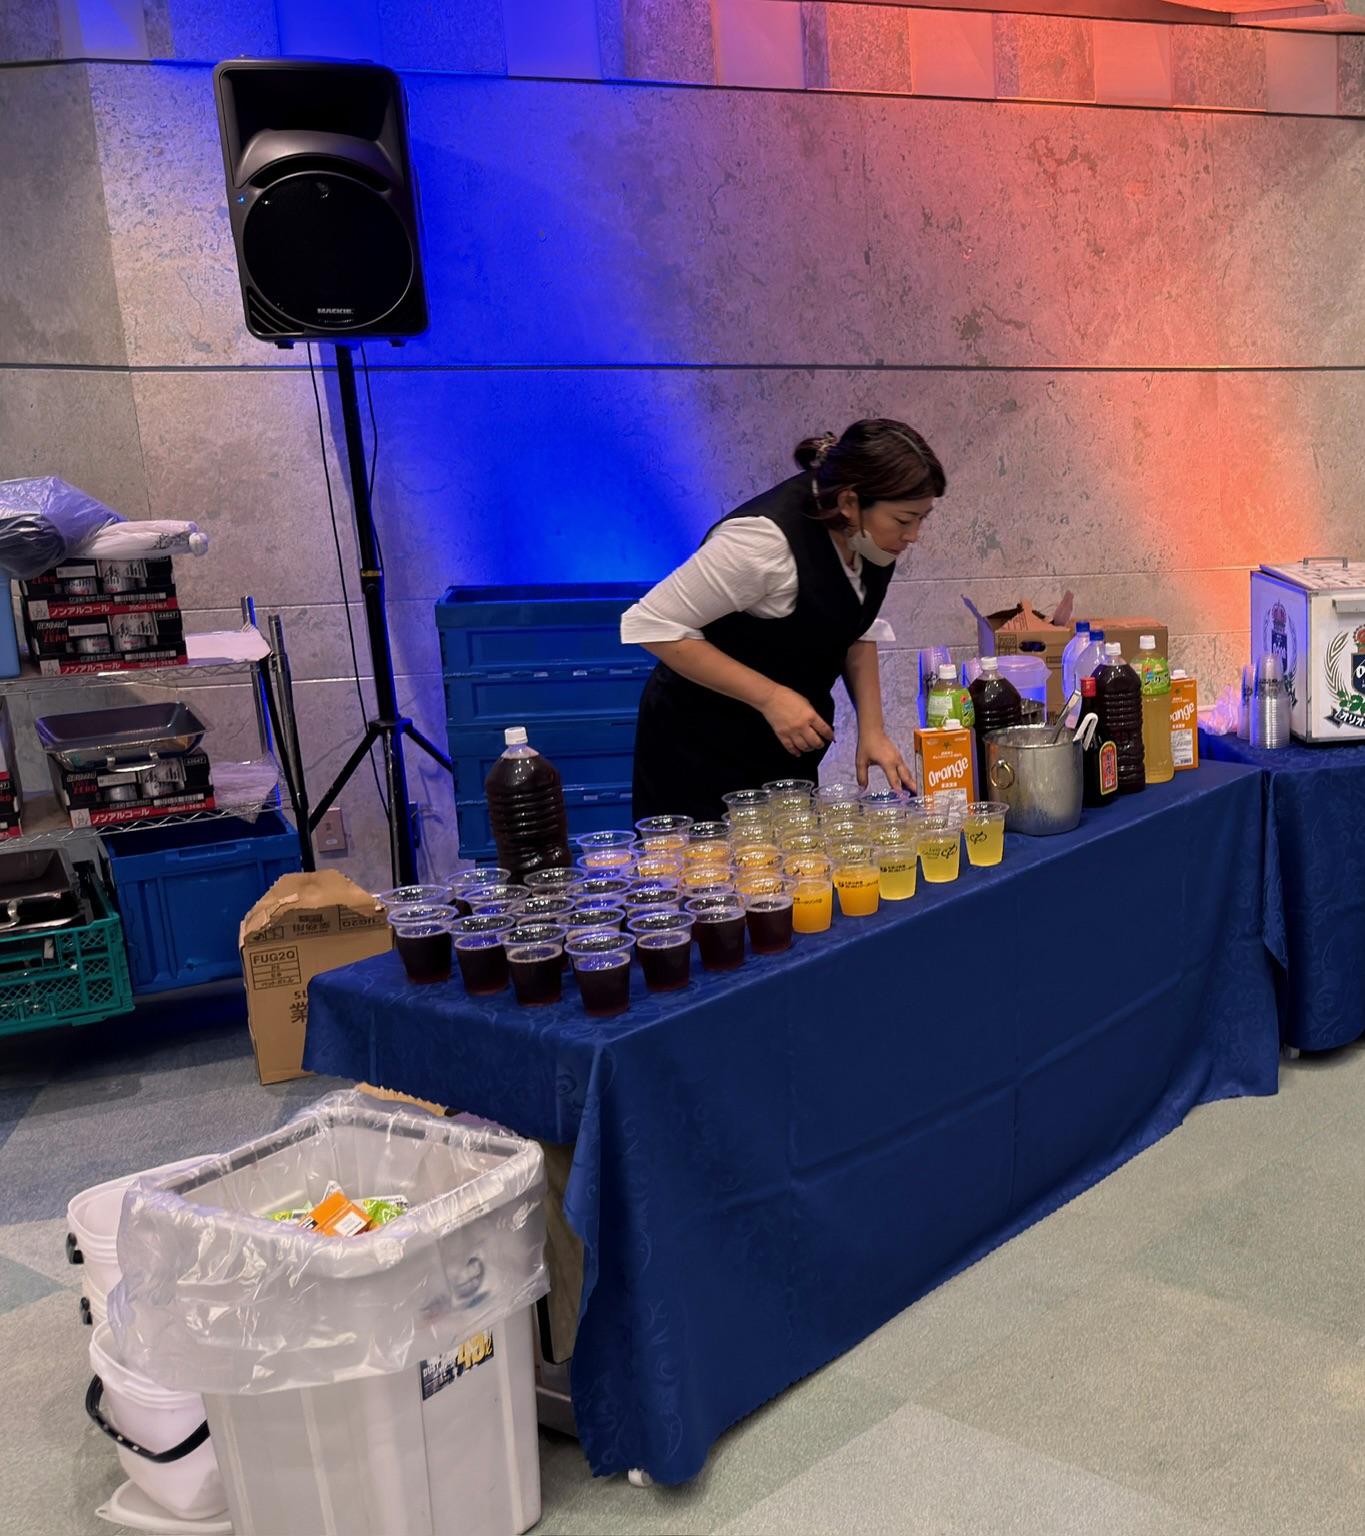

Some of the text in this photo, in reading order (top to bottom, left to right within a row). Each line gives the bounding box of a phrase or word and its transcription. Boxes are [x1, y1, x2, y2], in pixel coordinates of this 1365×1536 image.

[51, 604, 110, 617] ノンアルコール
[61, 662, 121, 675] ノンアルコール
[928, 757, 969, 787] Orange
[93, 809, 150, 824] ノンアルコール
